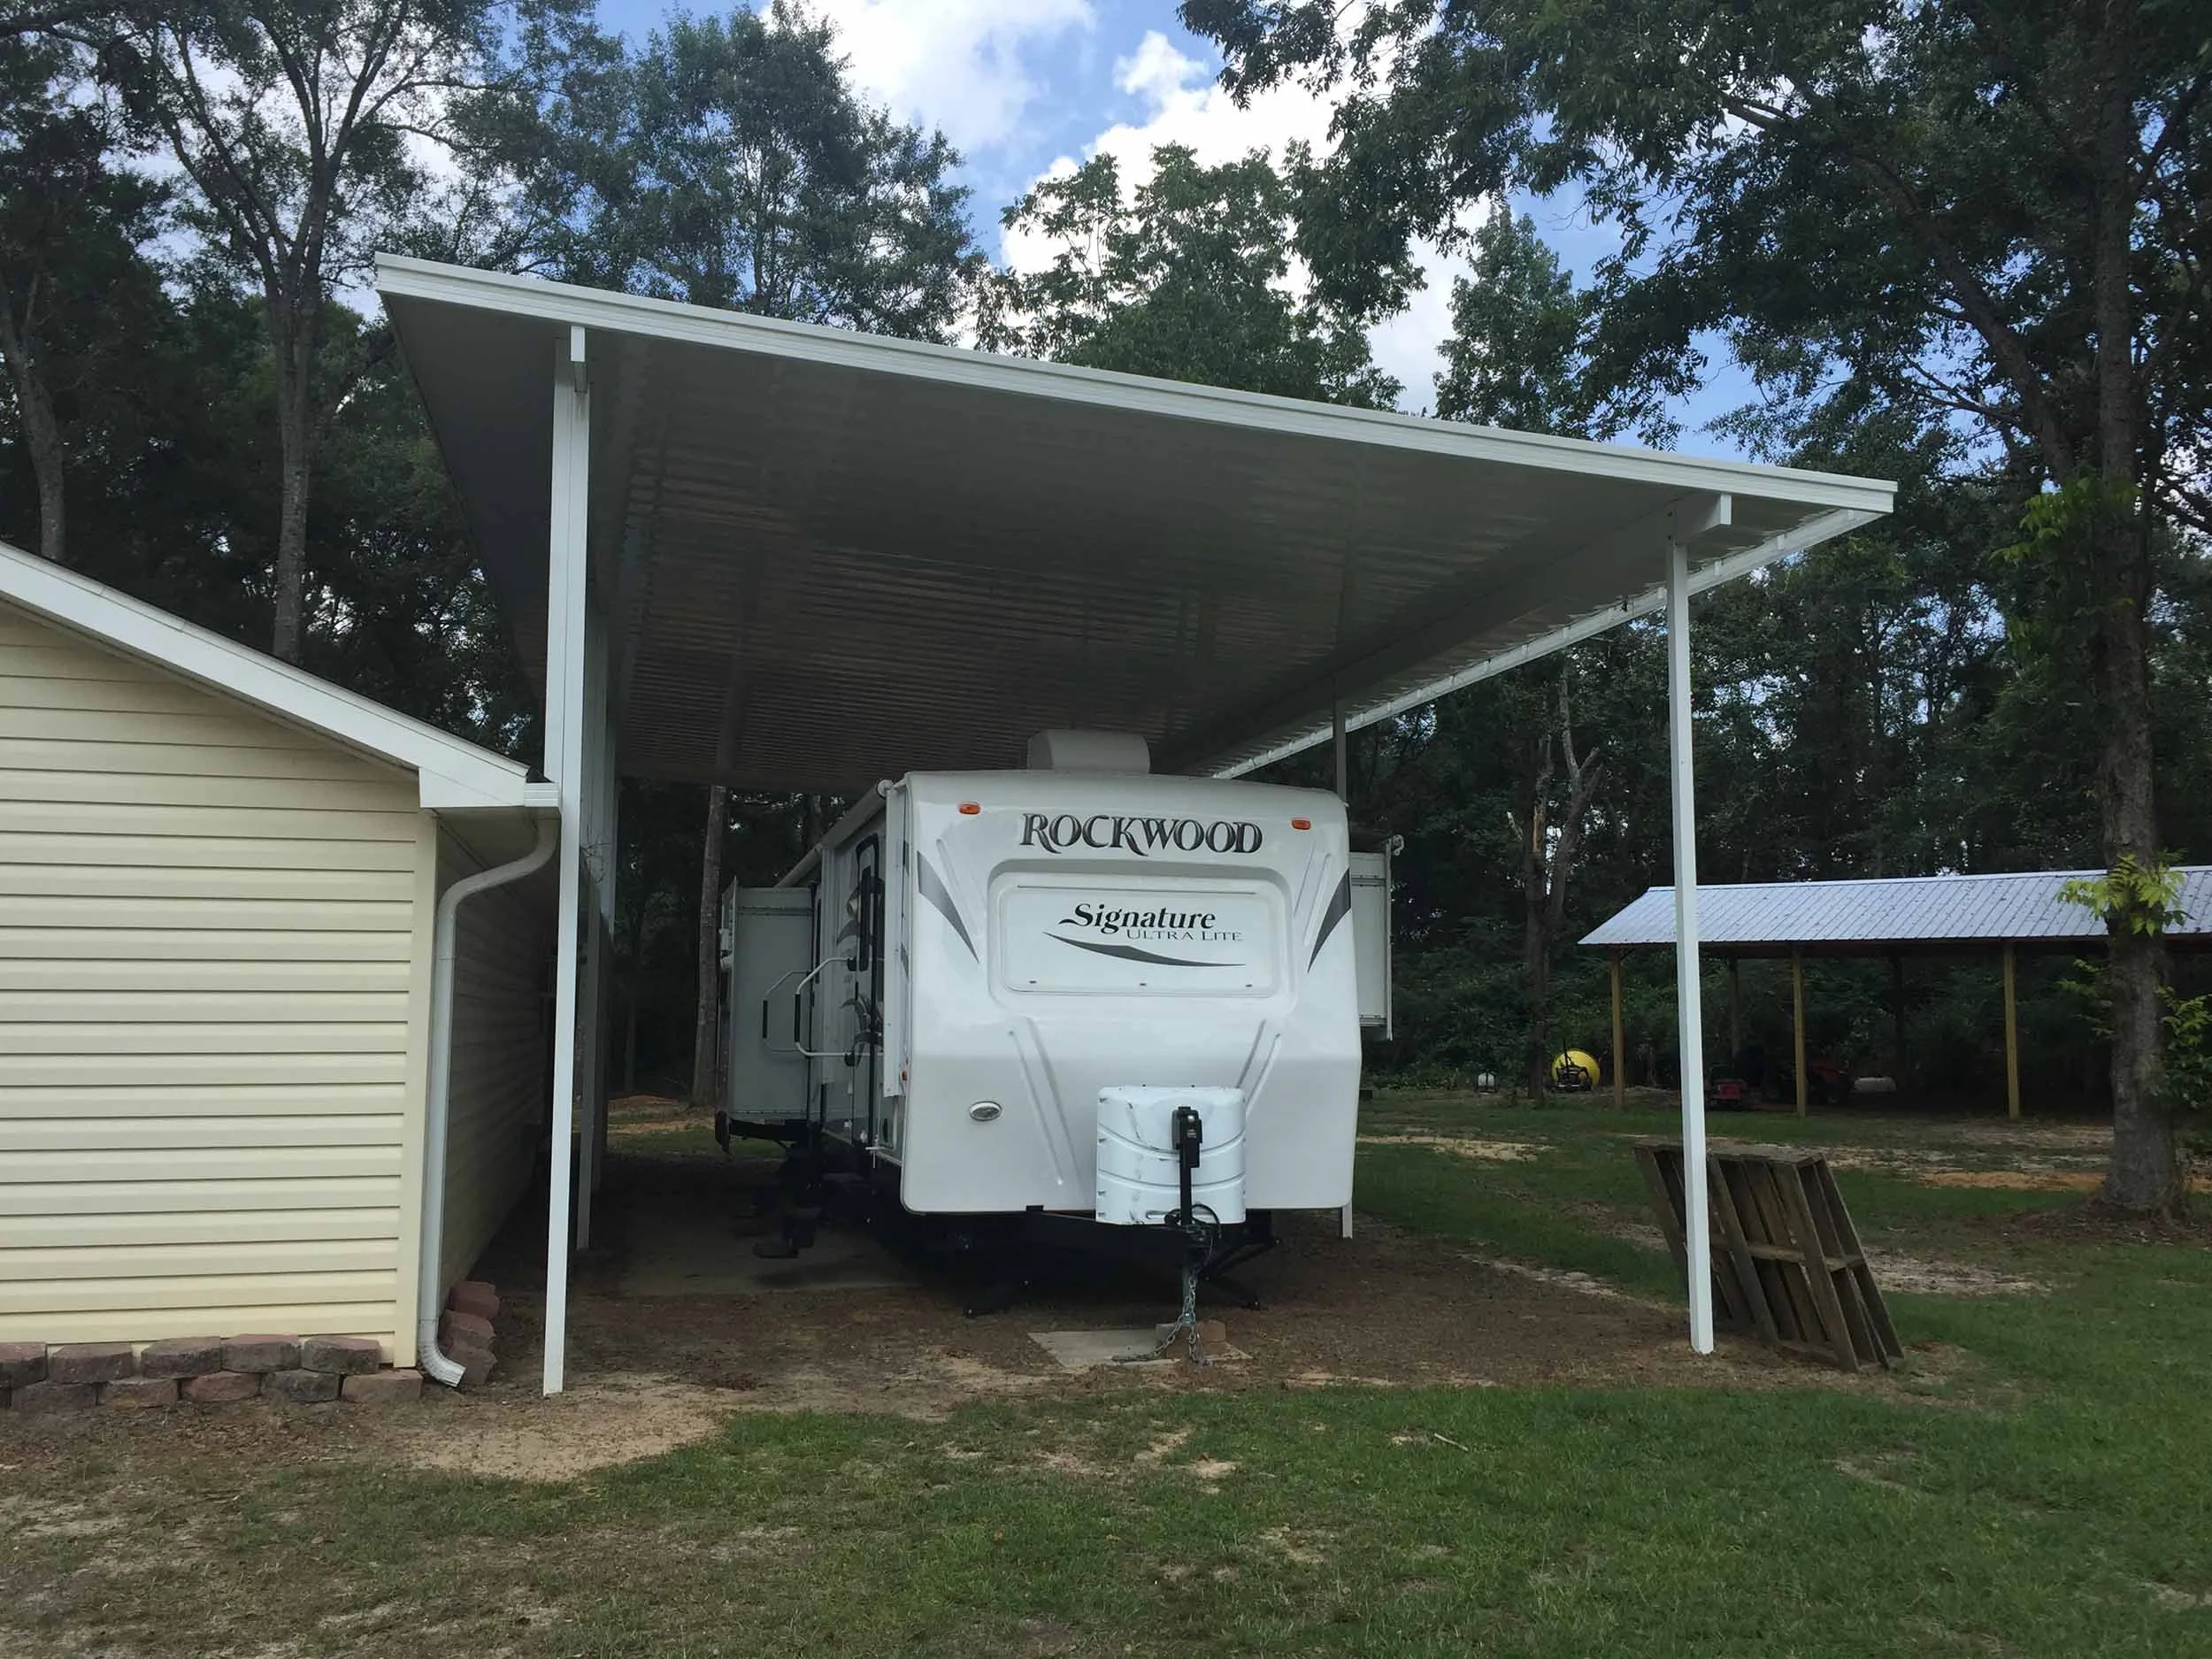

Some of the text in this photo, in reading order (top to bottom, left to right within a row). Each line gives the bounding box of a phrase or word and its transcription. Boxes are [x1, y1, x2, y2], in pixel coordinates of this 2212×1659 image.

[1019, 813, 1263, 856] ROCKWOOD
[1058, 902, 1216, 934] Signature
[1126, 930, 1242, 941] ULTRA LITE
